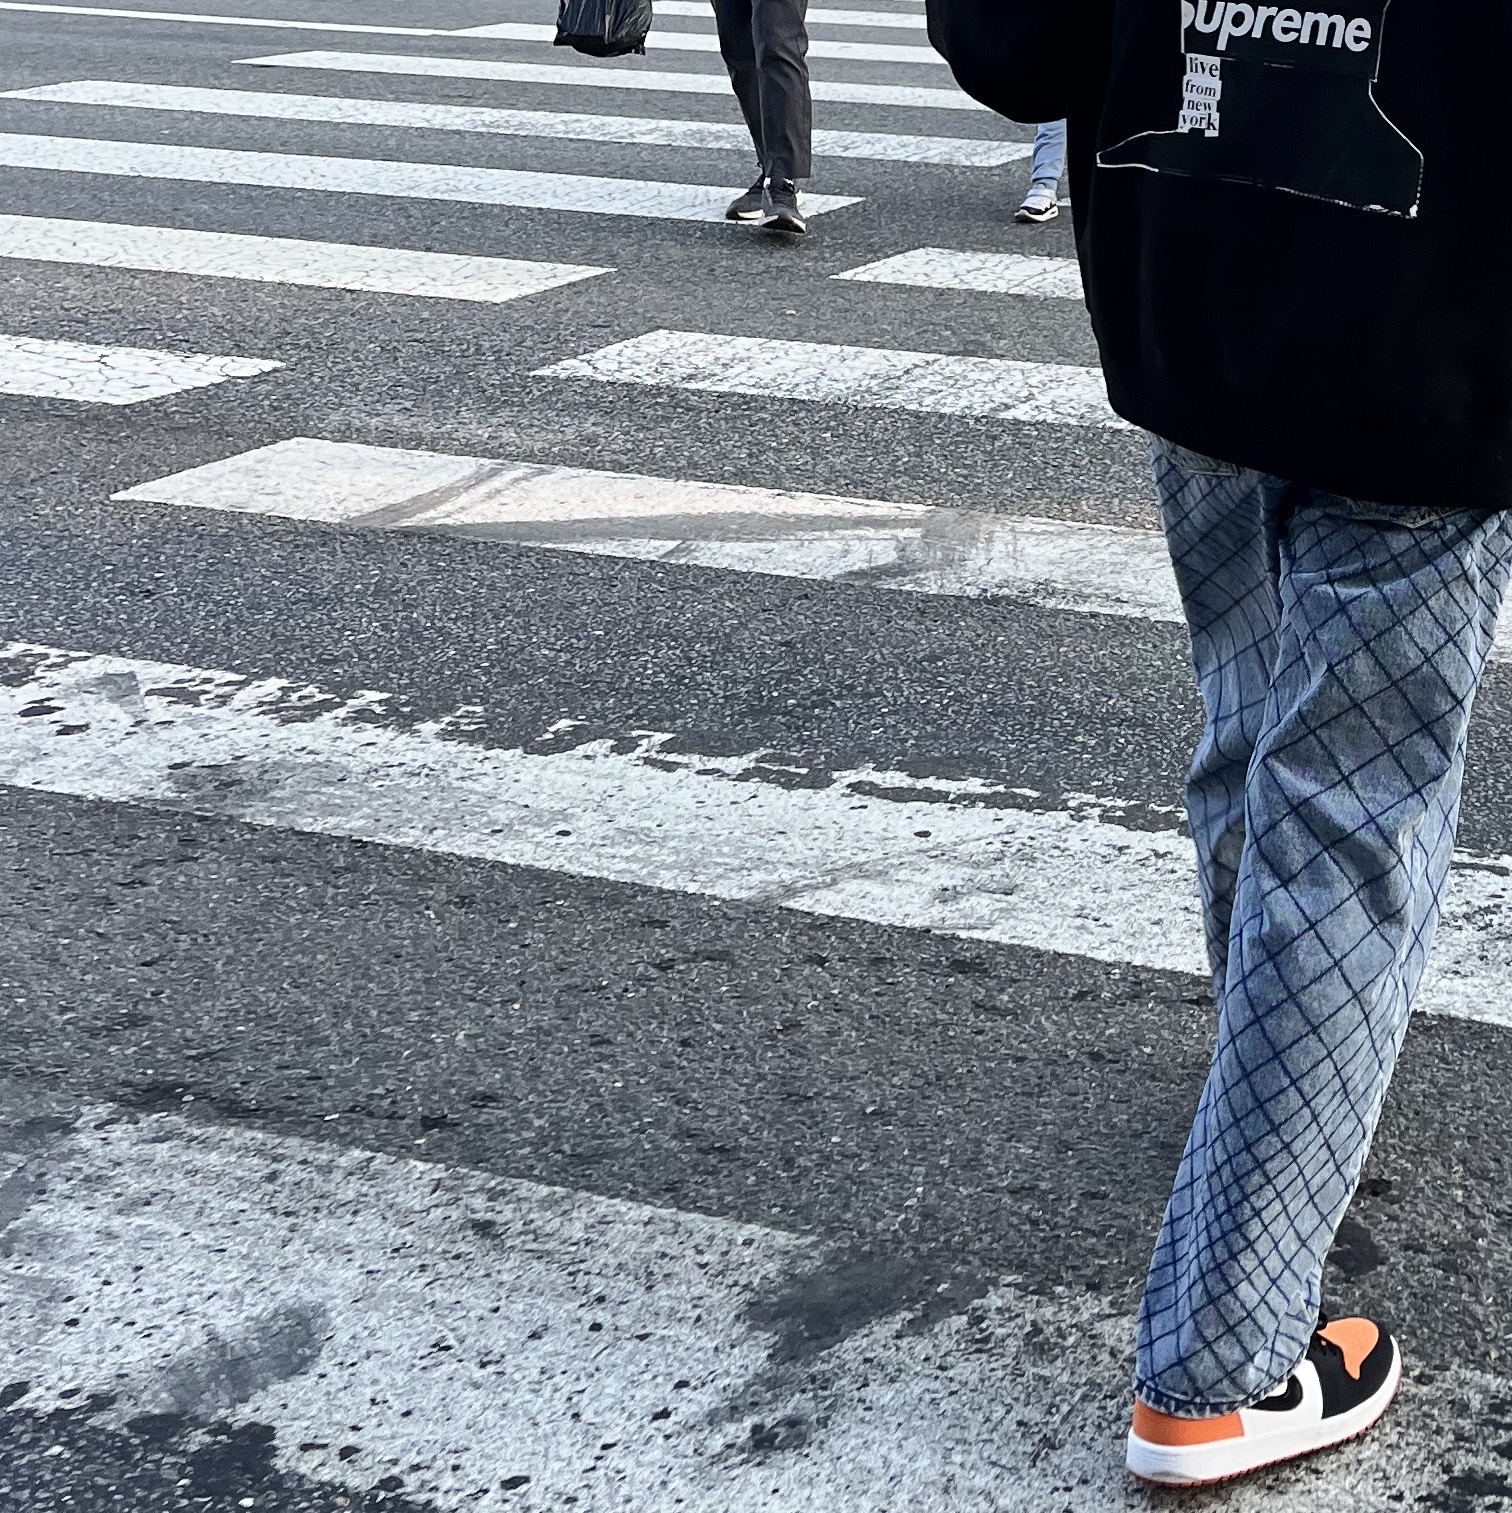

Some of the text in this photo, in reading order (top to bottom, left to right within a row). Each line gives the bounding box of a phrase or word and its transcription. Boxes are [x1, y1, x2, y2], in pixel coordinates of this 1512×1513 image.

[1189, 57, 1219, 77] live
[1185, 79, 1216, 97] from
[1187, 99, 1214, 111] new
[1180, 113, 1218, 130] york
